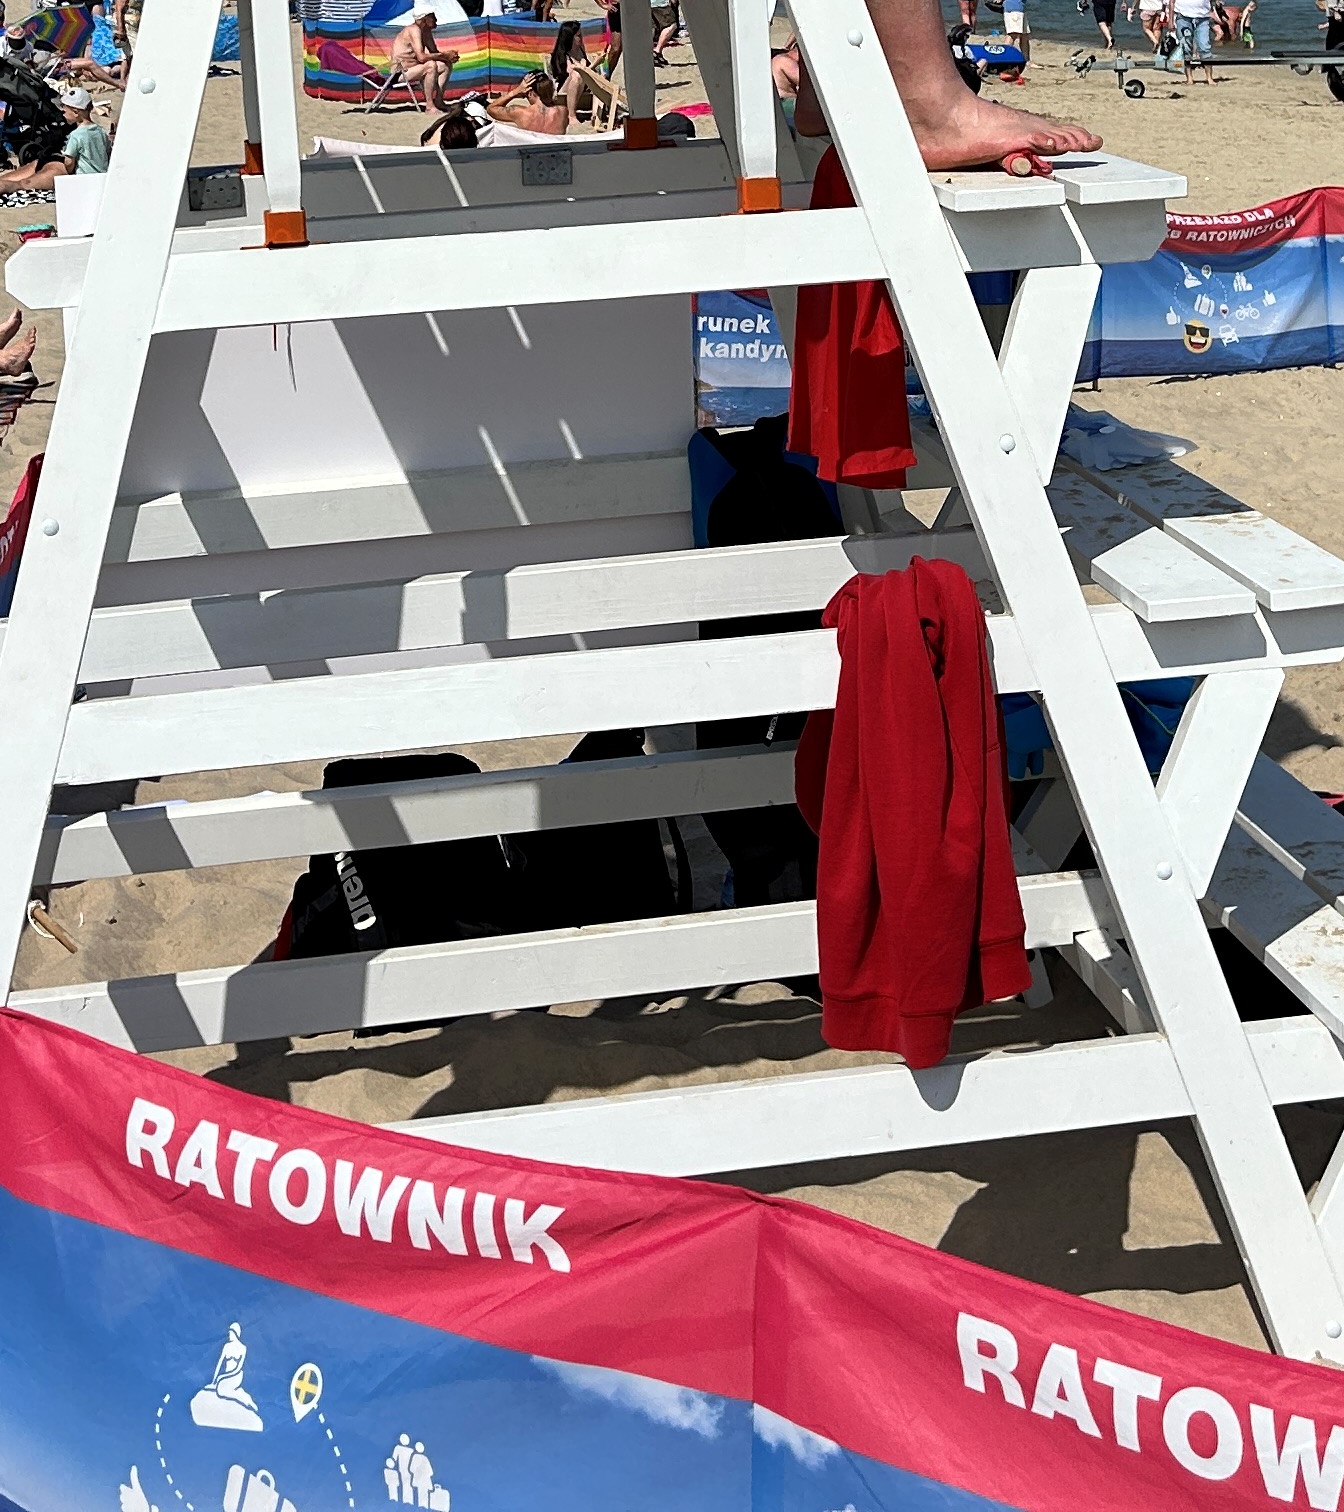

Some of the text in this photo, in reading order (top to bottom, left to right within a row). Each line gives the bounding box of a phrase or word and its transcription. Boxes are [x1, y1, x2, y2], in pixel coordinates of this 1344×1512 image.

[1166, 208, 1274, 226] PRZEJAZD DLA
[125, 1096, 571, 1274] RATOWNIK
